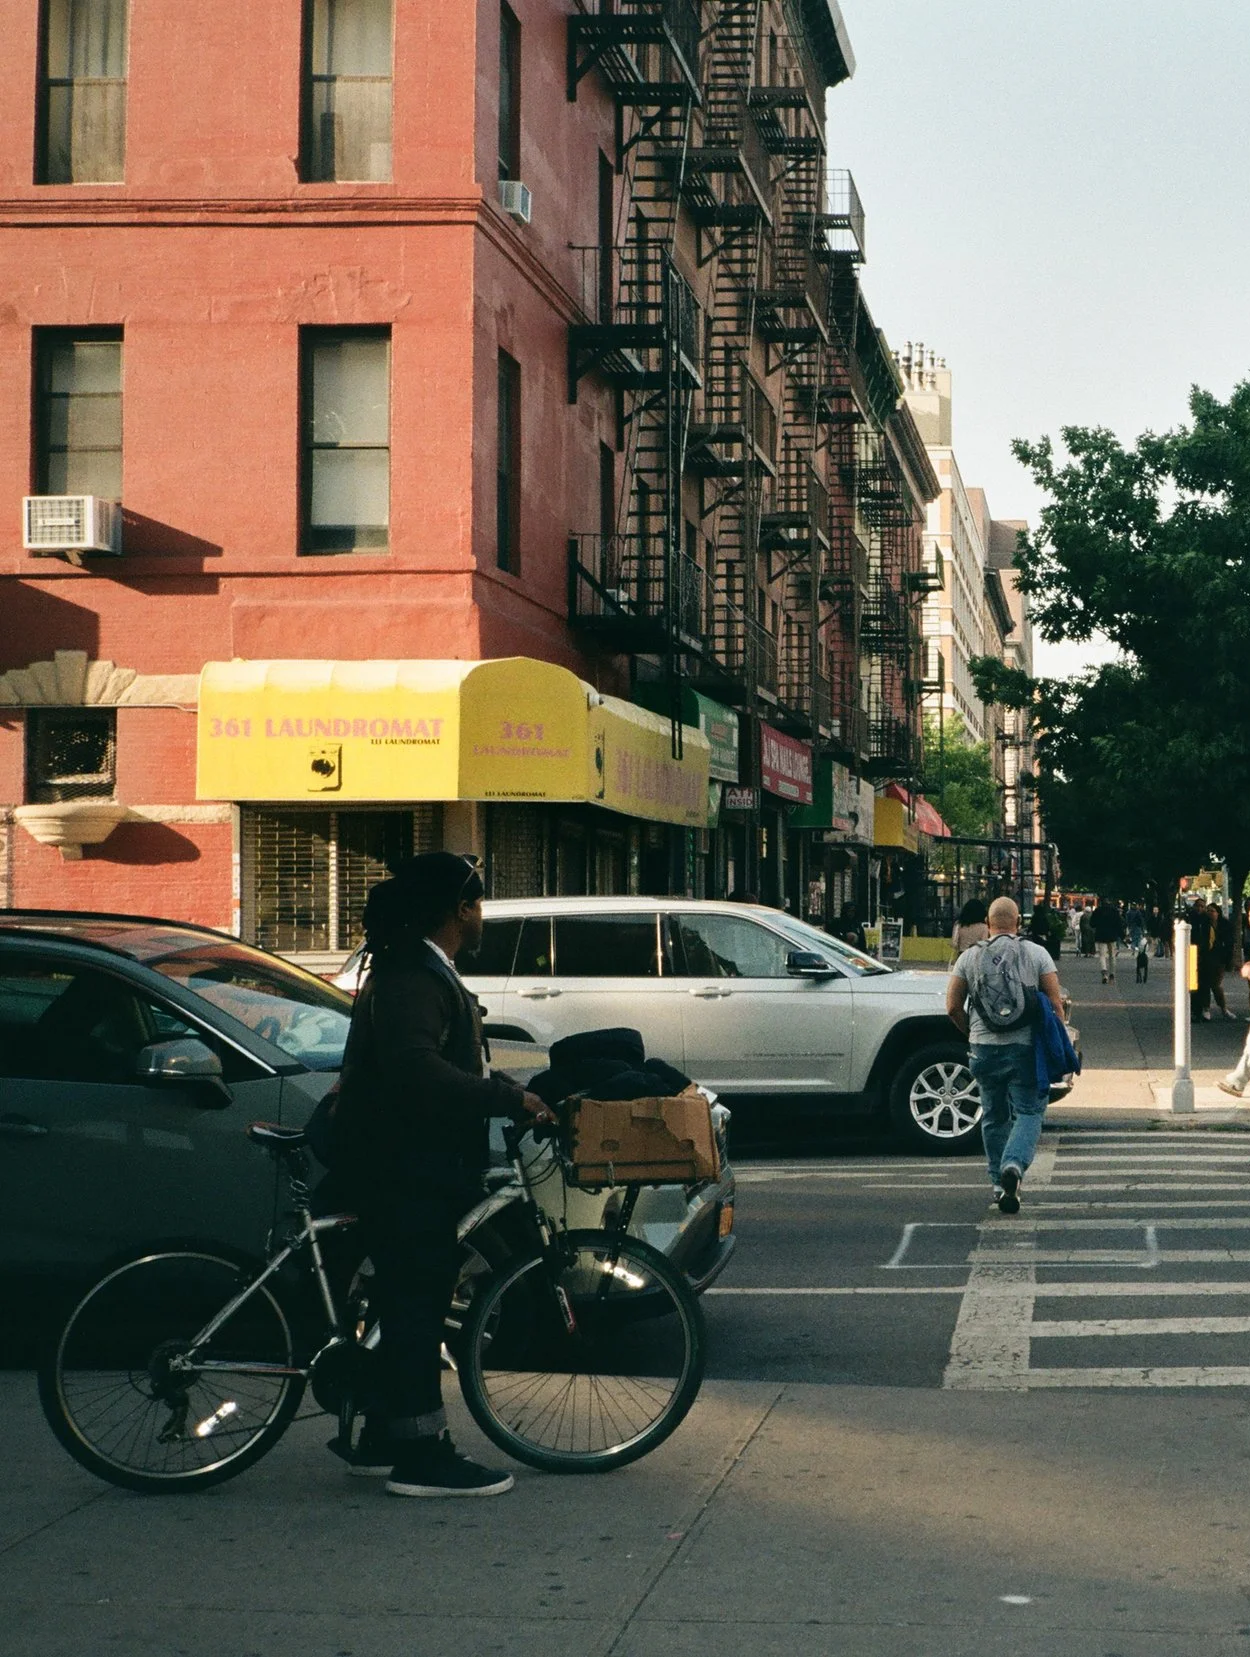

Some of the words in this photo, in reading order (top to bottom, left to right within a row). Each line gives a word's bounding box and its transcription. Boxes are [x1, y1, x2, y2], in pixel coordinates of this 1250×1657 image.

[209, 718, 252, 738] 361
[265, 718, 445, 738] LAUNDROMAT
[500, 720, 544, 741] 361
